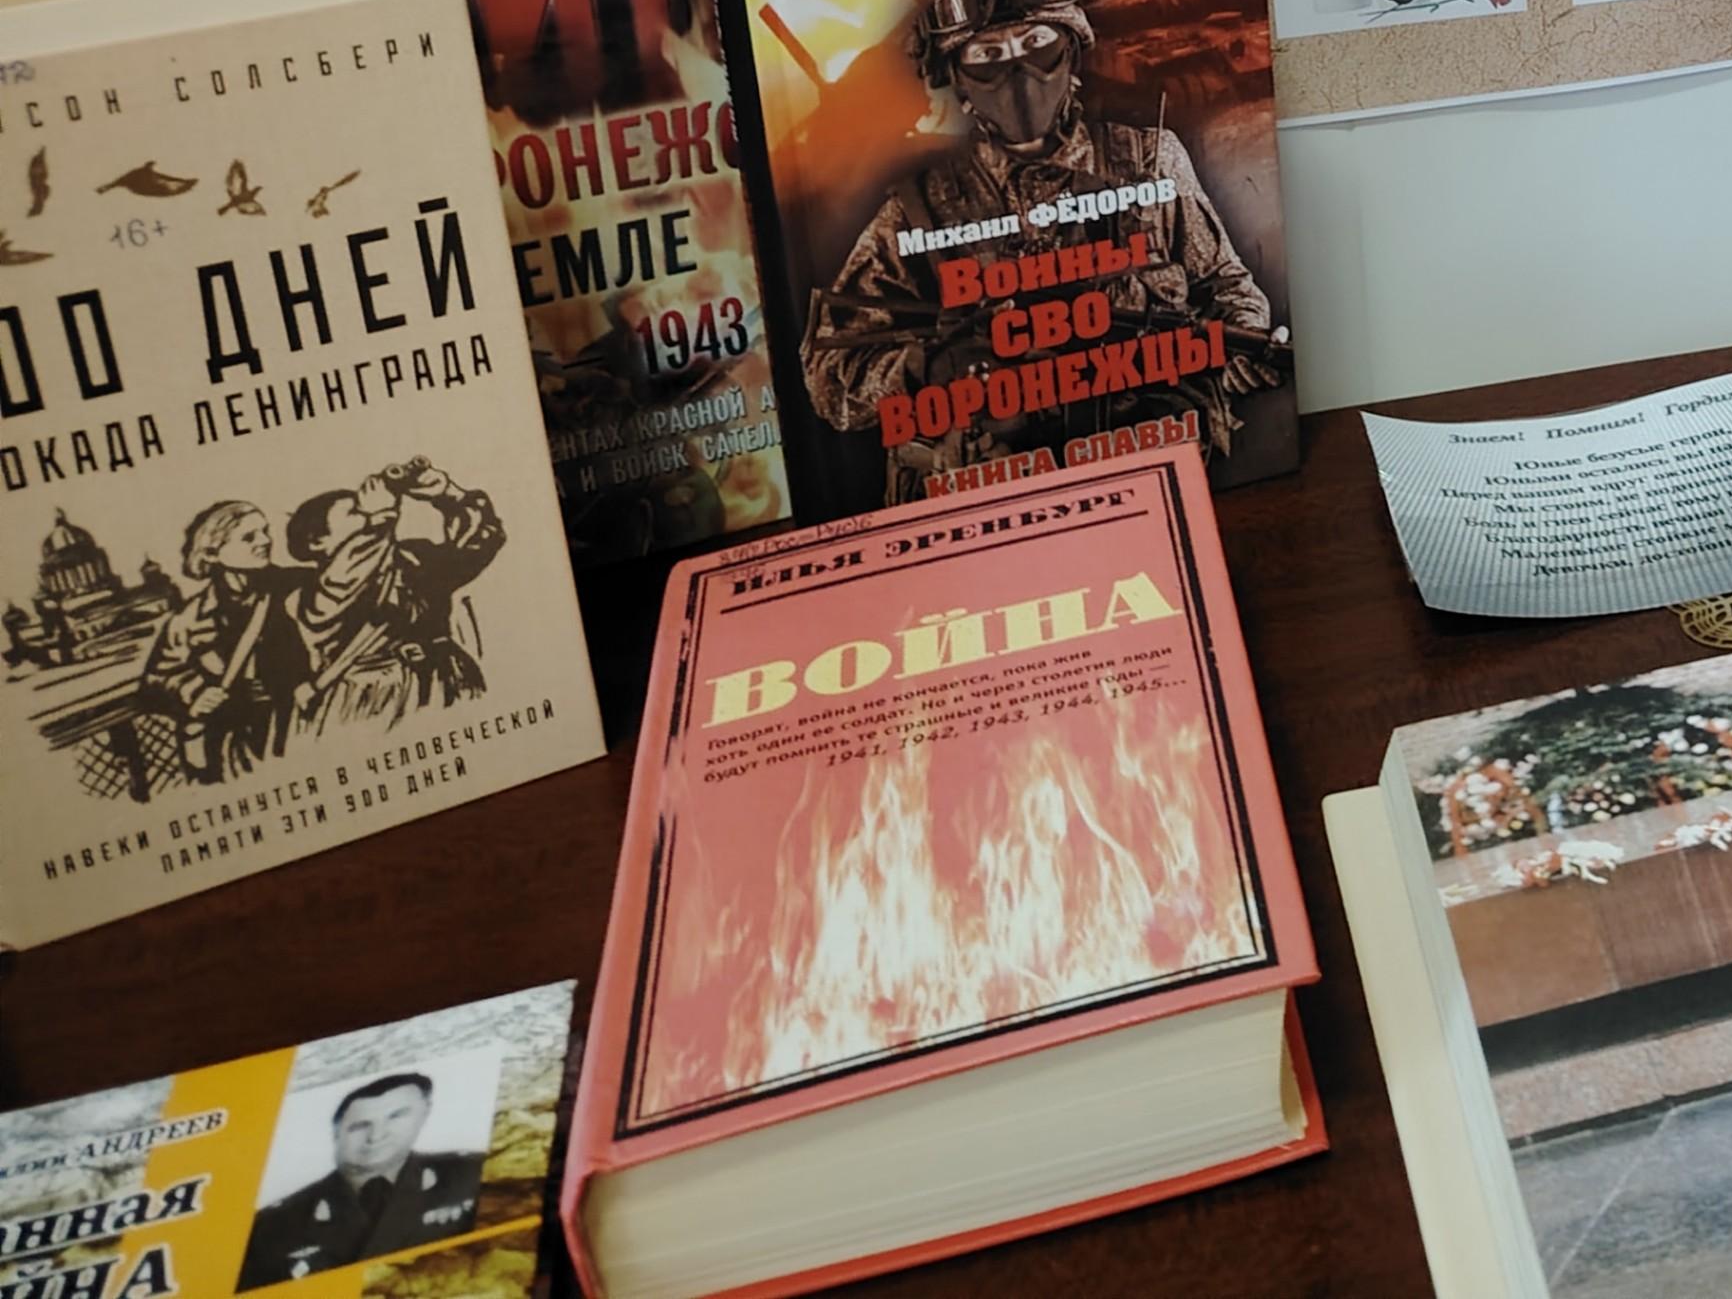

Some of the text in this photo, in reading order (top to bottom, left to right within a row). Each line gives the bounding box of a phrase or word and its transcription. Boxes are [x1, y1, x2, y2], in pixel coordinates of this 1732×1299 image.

[173, 32, 436, 102] СОЛСБЕРИ
[109, 218, 169, 248] 16+
[897, 177, 1180, 257] Михаил ФЁДОРОВ
[198, 198, 477, 384] ДНЕЙ
[936, 231, 1149, 308] Воины
[634, 297, 749, 378] 1943
[990, 292, 1112, 358] СВО
[193, 334, 493, 446] ЛЕНИНГРАДА
[877, 320, 1229, 449] ВОРОНЕЖЦЫ
[1064, 411, 1201, 467] СЛАВЫ
[1447, 430, 1525, 446] Знаем!
[1545, 411, 1646, 442] Помним!
[729, 549, 866, 596] ИЛЬЯ
[884, 487, 1136, 560] ЭРЕНБУРГ
[701, 572, 1184, 729] ВОЙНА
[44, 697, 558, 881] НАВЕКИ ОСТАНУТСЯ В ЧЕЛОВЕЧЕСКОЙ
[160, 755, 471, 875] ПАМЯТИ ЭТИ 900 ДНЕЙ
[77, 1110, 227, 1164] АНДРЕЕВ
